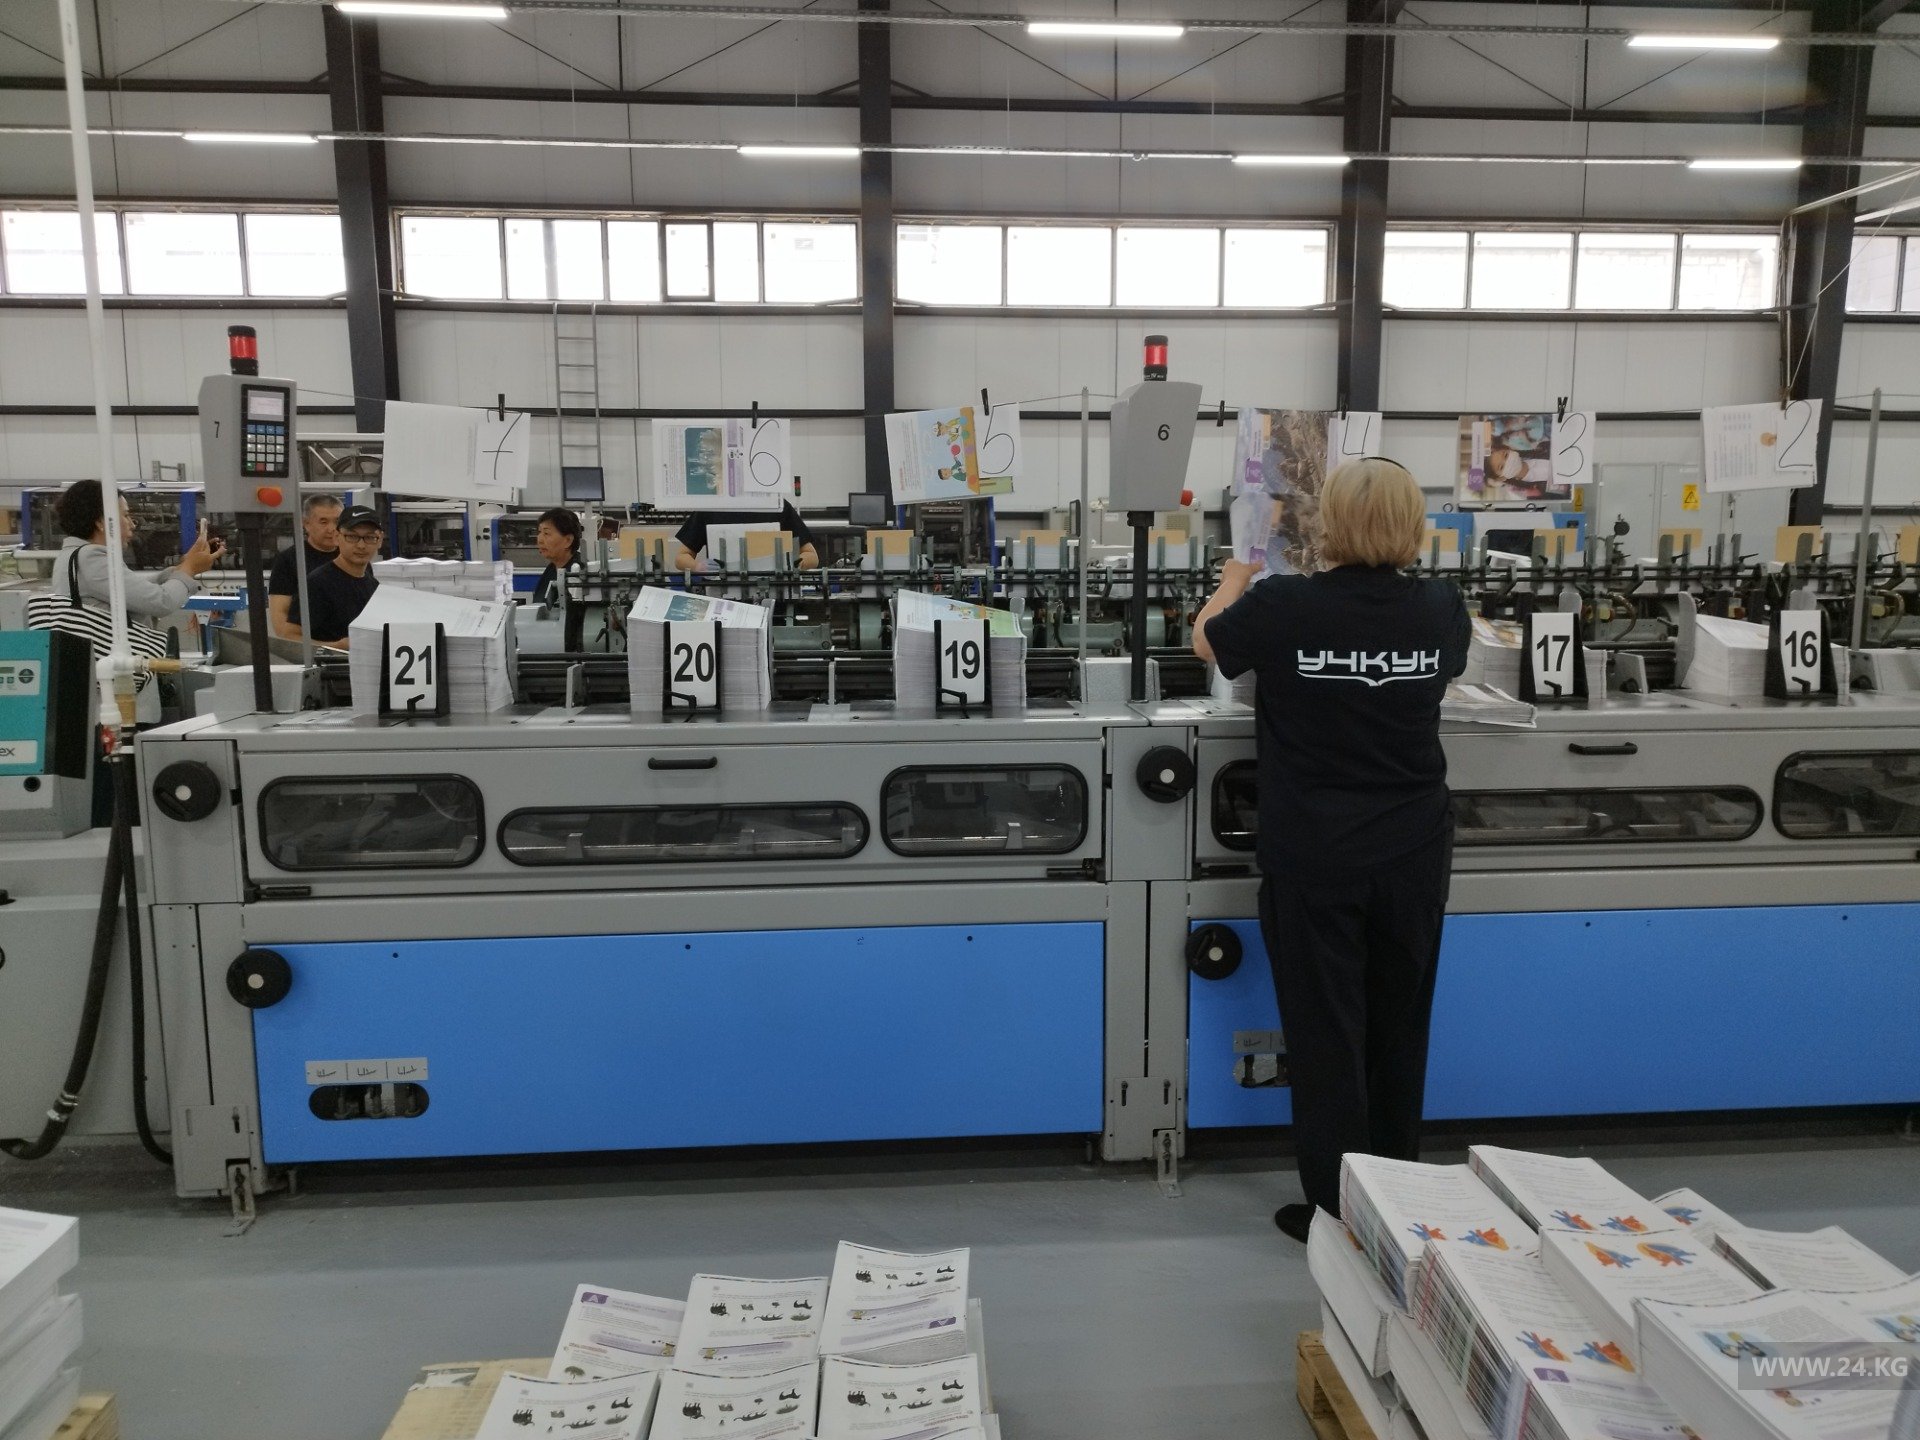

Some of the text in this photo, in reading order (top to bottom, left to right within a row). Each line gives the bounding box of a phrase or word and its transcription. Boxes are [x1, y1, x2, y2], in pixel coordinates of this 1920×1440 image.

[214, 420, 220, 439] 7
[482, 409, 523, 480] 7
[982, 401, 1017, 475] 5
[1157, 424, 1171, 441] 6
[1556, 413, 1588, 478] 3
[1778, 400, 1814, 469] 2
[750, 418, 782, 487] 6
[394, 645, 433, 686] 21
[673, 642, 715, 683] 20
[944, 640, 981, 680] 19
[1296, 648, 1441, 673] УЧКУН
[1536, 633, 1571, 673] 17
[1784, 630, 1818, 668] 16
